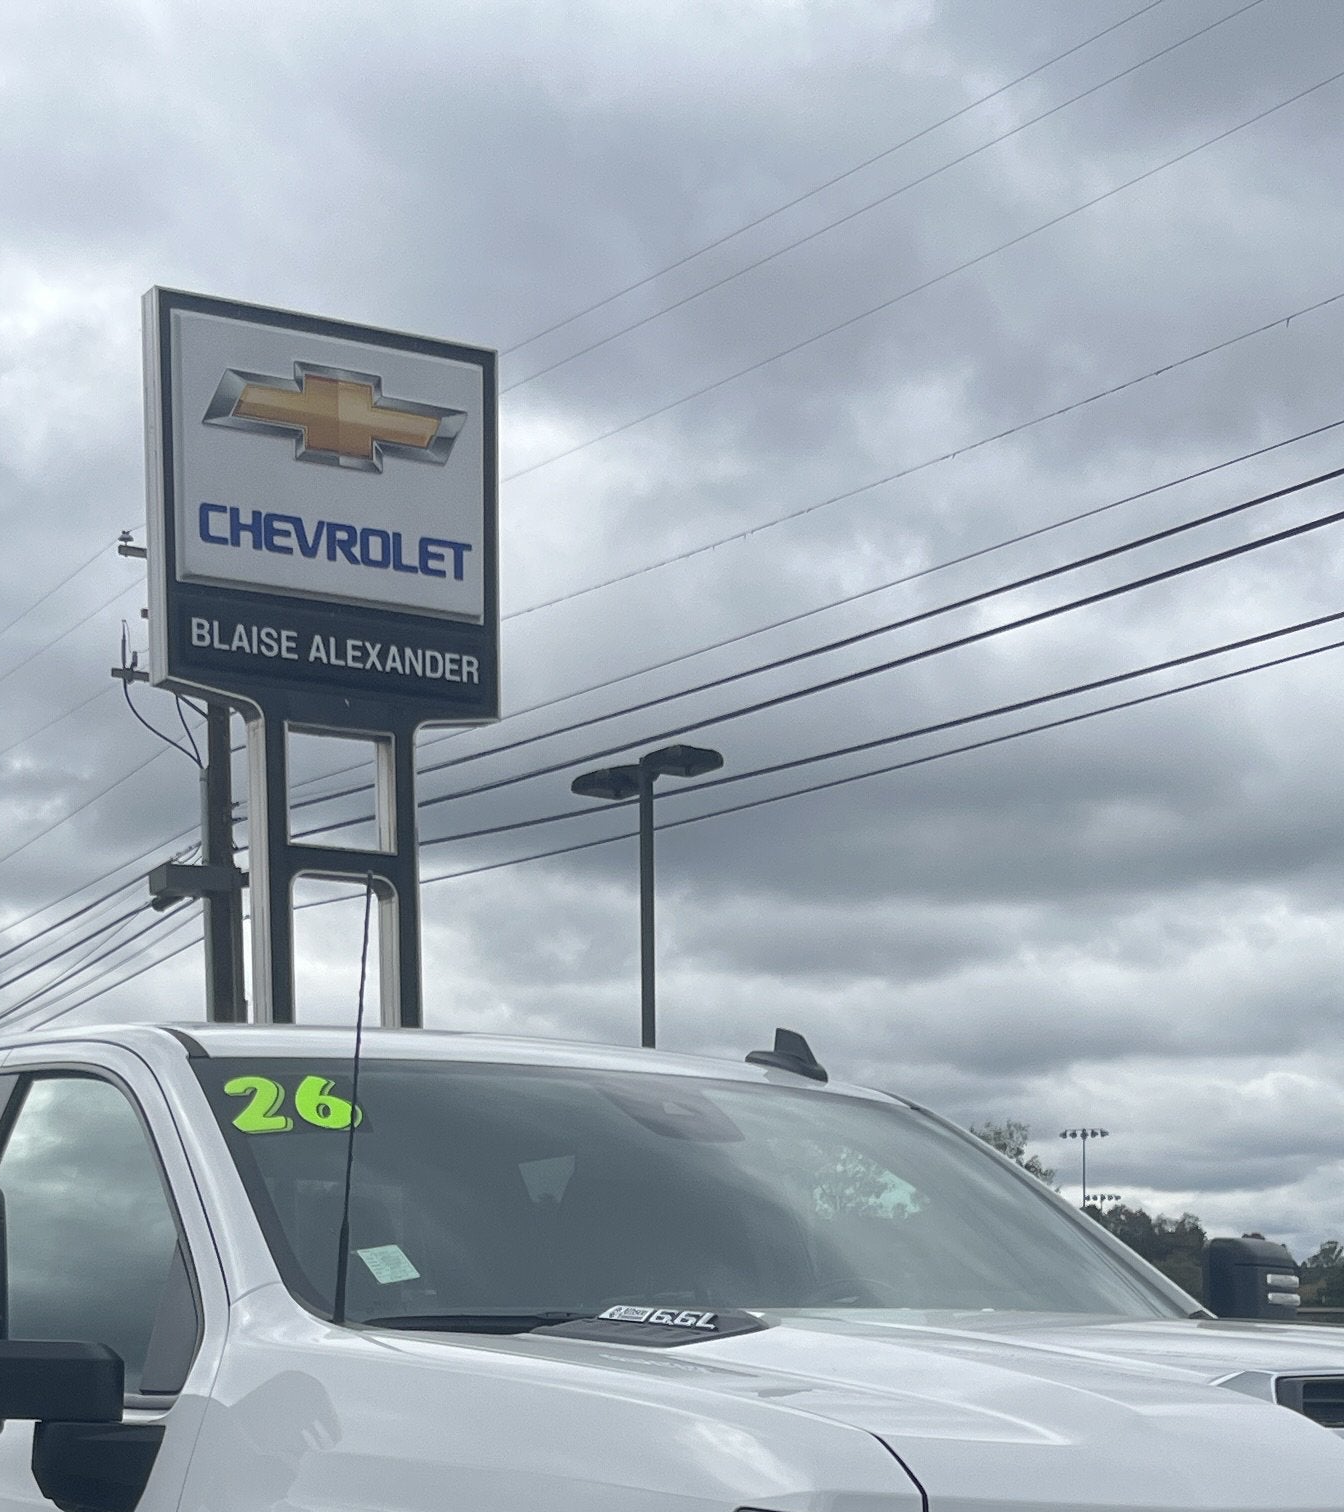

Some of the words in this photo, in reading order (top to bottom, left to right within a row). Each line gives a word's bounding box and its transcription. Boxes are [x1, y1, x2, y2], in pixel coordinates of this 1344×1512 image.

[199, 502, 472, 581] CHEVROLET
[191, 616, 298, 660] BLAISE
[309, 634, 480, 685] ALEXANDER
[224, 1075, 363, 1135] 26
